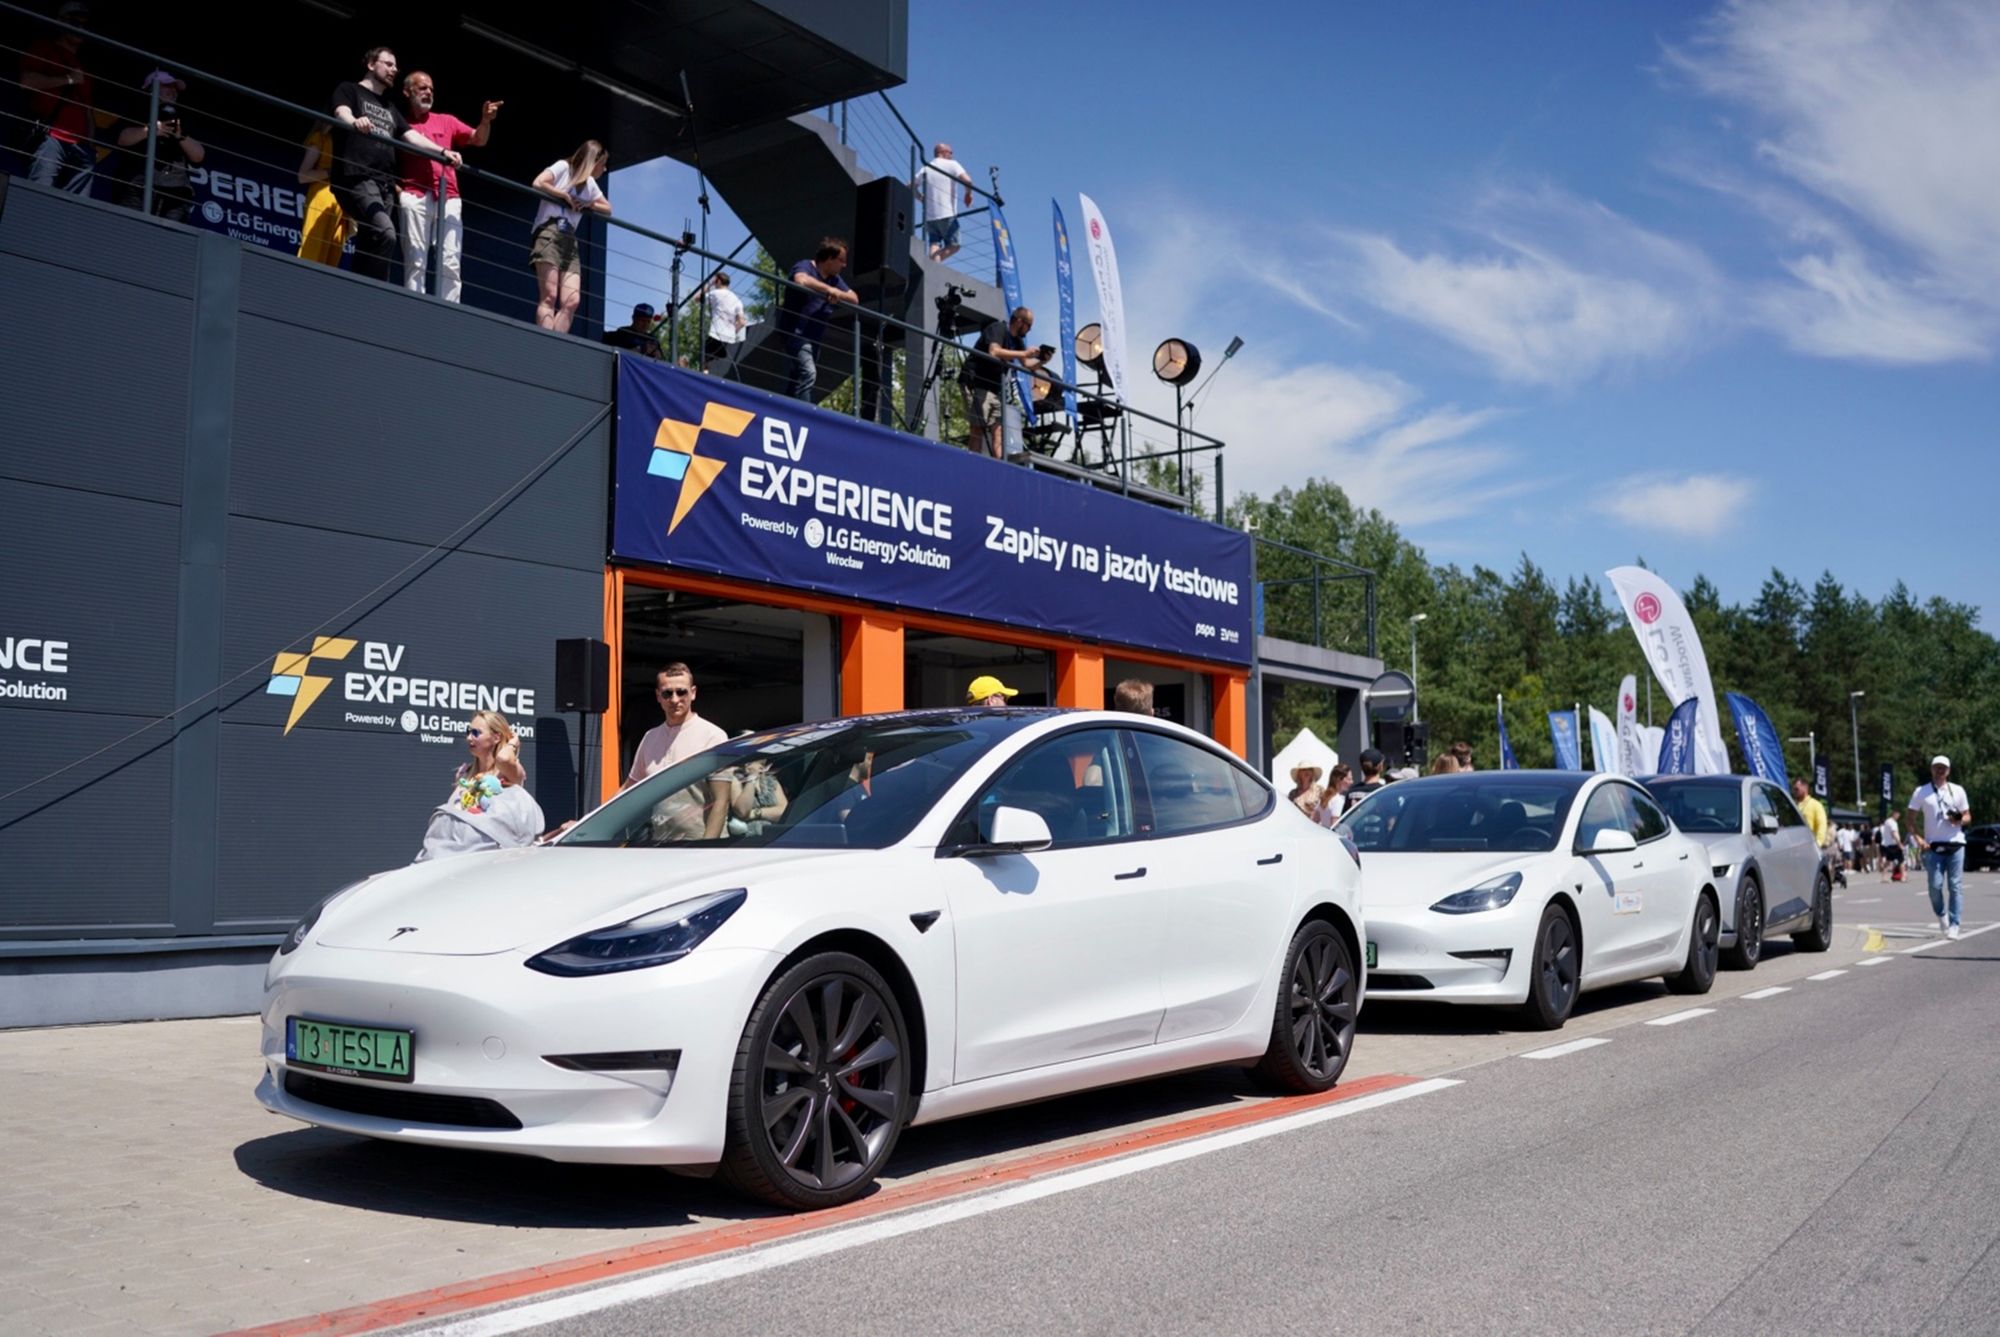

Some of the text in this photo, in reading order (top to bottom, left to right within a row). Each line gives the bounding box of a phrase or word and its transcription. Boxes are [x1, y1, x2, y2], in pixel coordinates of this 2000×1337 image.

[227, 208, 250, 228] LG
[227, 228, 270, 246] Wrocław
[762, 416, 809, 462] EV
[740, 456, 952, 540] EXPERIENCE
[741, 512, 951, 570] Powered by LG Energy Solution
[826, 552, 864, 570] Wrocław
[985, 515, 1239, 605] Zapisy na jazdy testowe
[363, 641, 405, 672] EV
[344, 672, 535, 716] EXPERIENCE
[345, 712, 384, 725] Powered
[385, 715, 396, 727] by
[420, 715, 439, 731] LG
[442, 717, 471, 732] Ener
[420, 733, 454, 744] Wrocław
[298, 1024, 405, 1070] T3 TESLA
